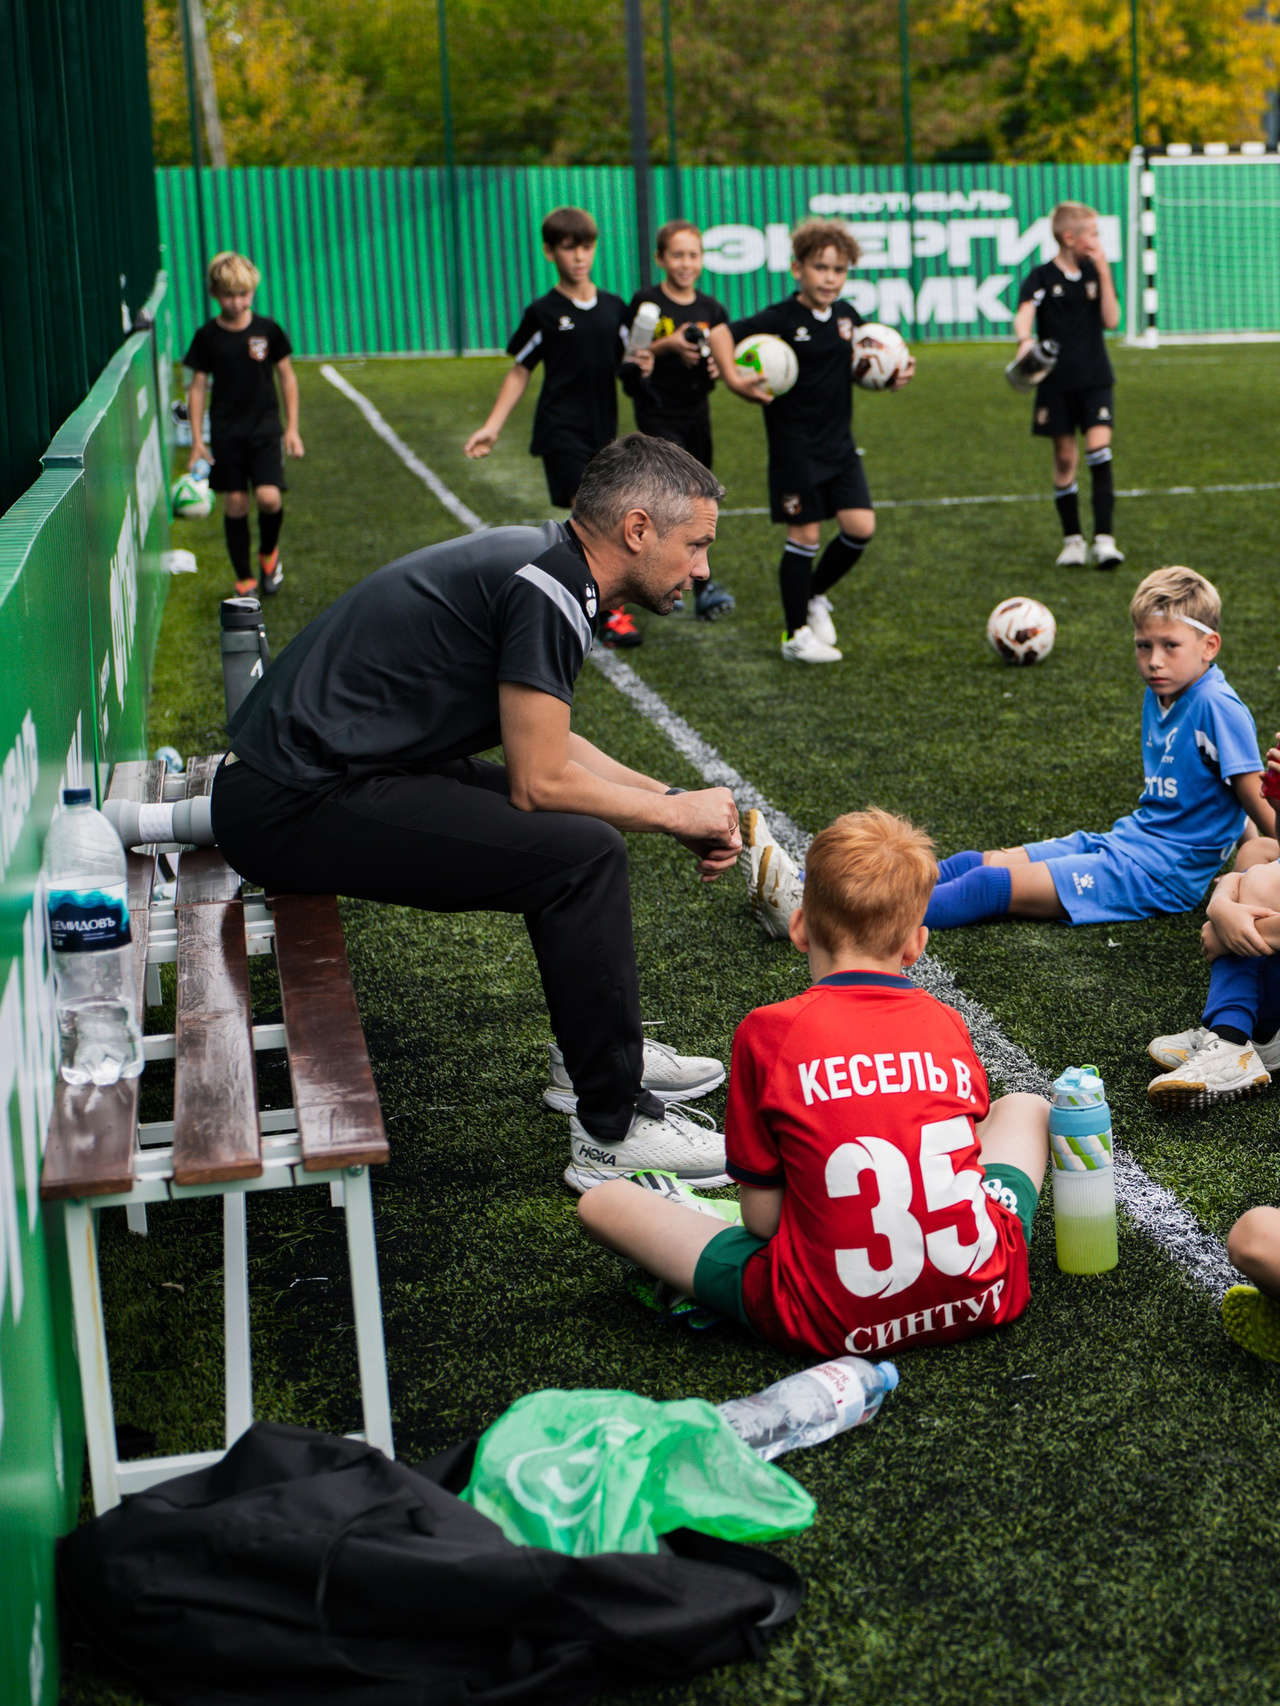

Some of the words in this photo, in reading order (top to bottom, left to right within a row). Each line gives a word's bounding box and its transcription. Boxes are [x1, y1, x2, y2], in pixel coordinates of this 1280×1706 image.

[1145, 776, 1178, 798] TIS
[798, 1051, 949, 1106] КЕСЕЛЬ
[579, 1144, 616, 1166] HOKA
[825, 1115, 998, 1299] 35
[845, 1278, 1005, 1354] СИНТУР
